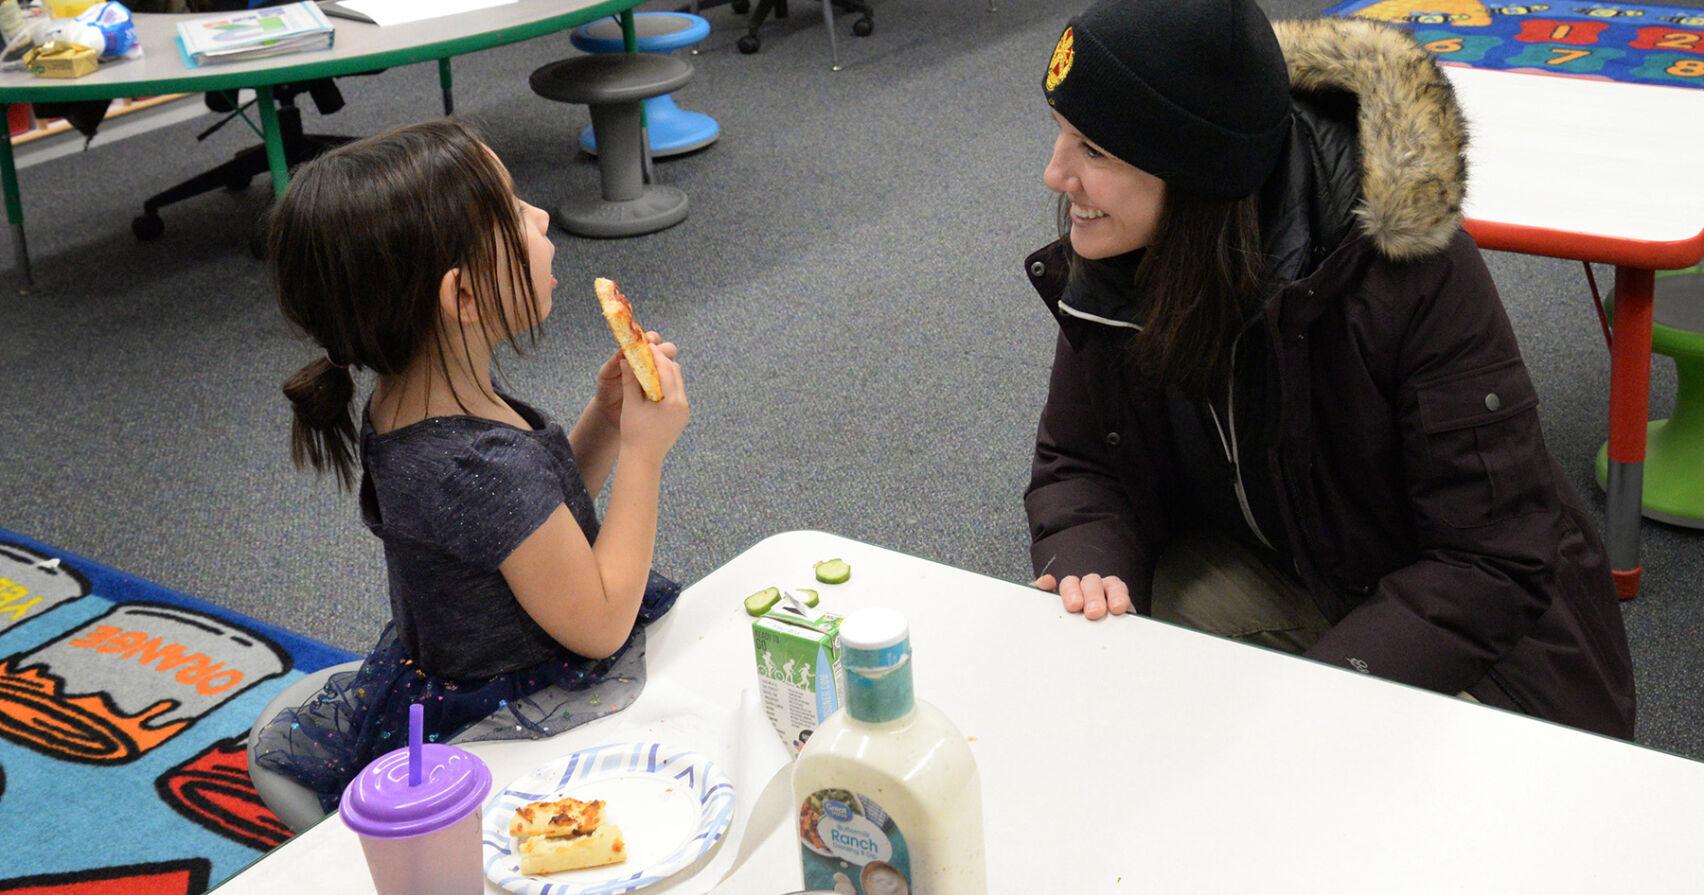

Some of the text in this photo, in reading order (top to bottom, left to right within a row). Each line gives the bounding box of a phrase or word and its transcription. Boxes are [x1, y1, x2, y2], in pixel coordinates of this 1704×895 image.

[1551, 25, 1701, 49] 1 2
[1424, 38, 1704, 77] 6 7 8
[68, 625, 245, 696] ORANGE
[831, 829, 879, 853] Ranch
